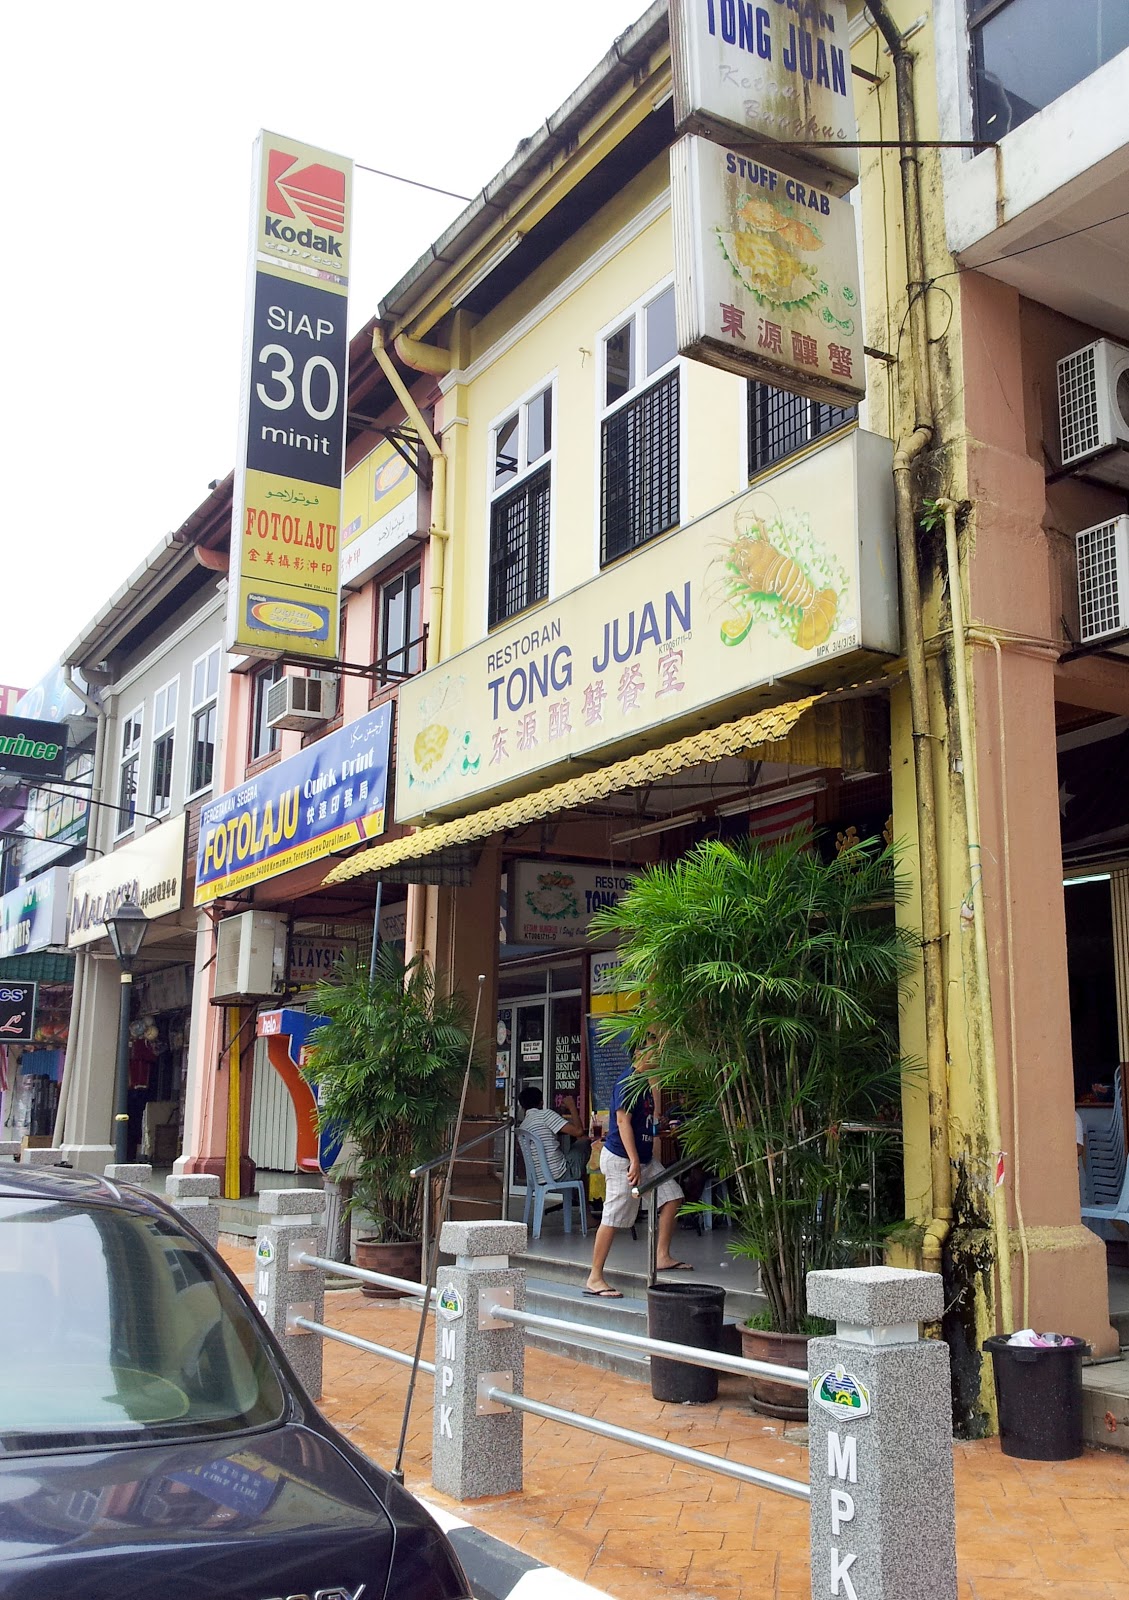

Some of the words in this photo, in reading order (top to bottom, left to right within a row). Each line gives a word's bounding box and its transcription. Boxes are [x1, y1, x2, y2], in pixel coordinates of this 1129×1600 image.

[783, 23, 847, 97] JUAN
[726, 152, 778, 192] STUFF
[785, 179, 831, 216] CRAB
[264, 215, 343, 258] Kodak
[267, 305, 335, 342] SIAP
[256, 343, 339, 421] 30
[261, 424, 330, 456] minit
[245, 507, 337, 553] FOTOLAJU
[487, 617, 562, 674] RESTORAN
[488, 645, 573, 721] TONG
[592, 581, 692, 674] JUAN
[303, 768, 337, 800] Quick
[341, 746, 375, 781] Print
[237, 783, 258, 808] SEGERA
[203, 785, 300, 876] FOTOLAJU
[293, 844, 322, 861] Terengganu
[556, 1036, 569, 1045] KAD
[571, 1035, 581, 1044] NA
[556, 1053, 569, 1062] KAD
[571, 1053, 581, 1062] KA
[555, 1062, 573, 1071] RESIT
[555, 1070, 580, 1080] BORANG
[555, 1081, 576, 1090] INBOIS
[440, 1327, 457, 1439] MPK
[827, 1430, 858, 1600] MPK
